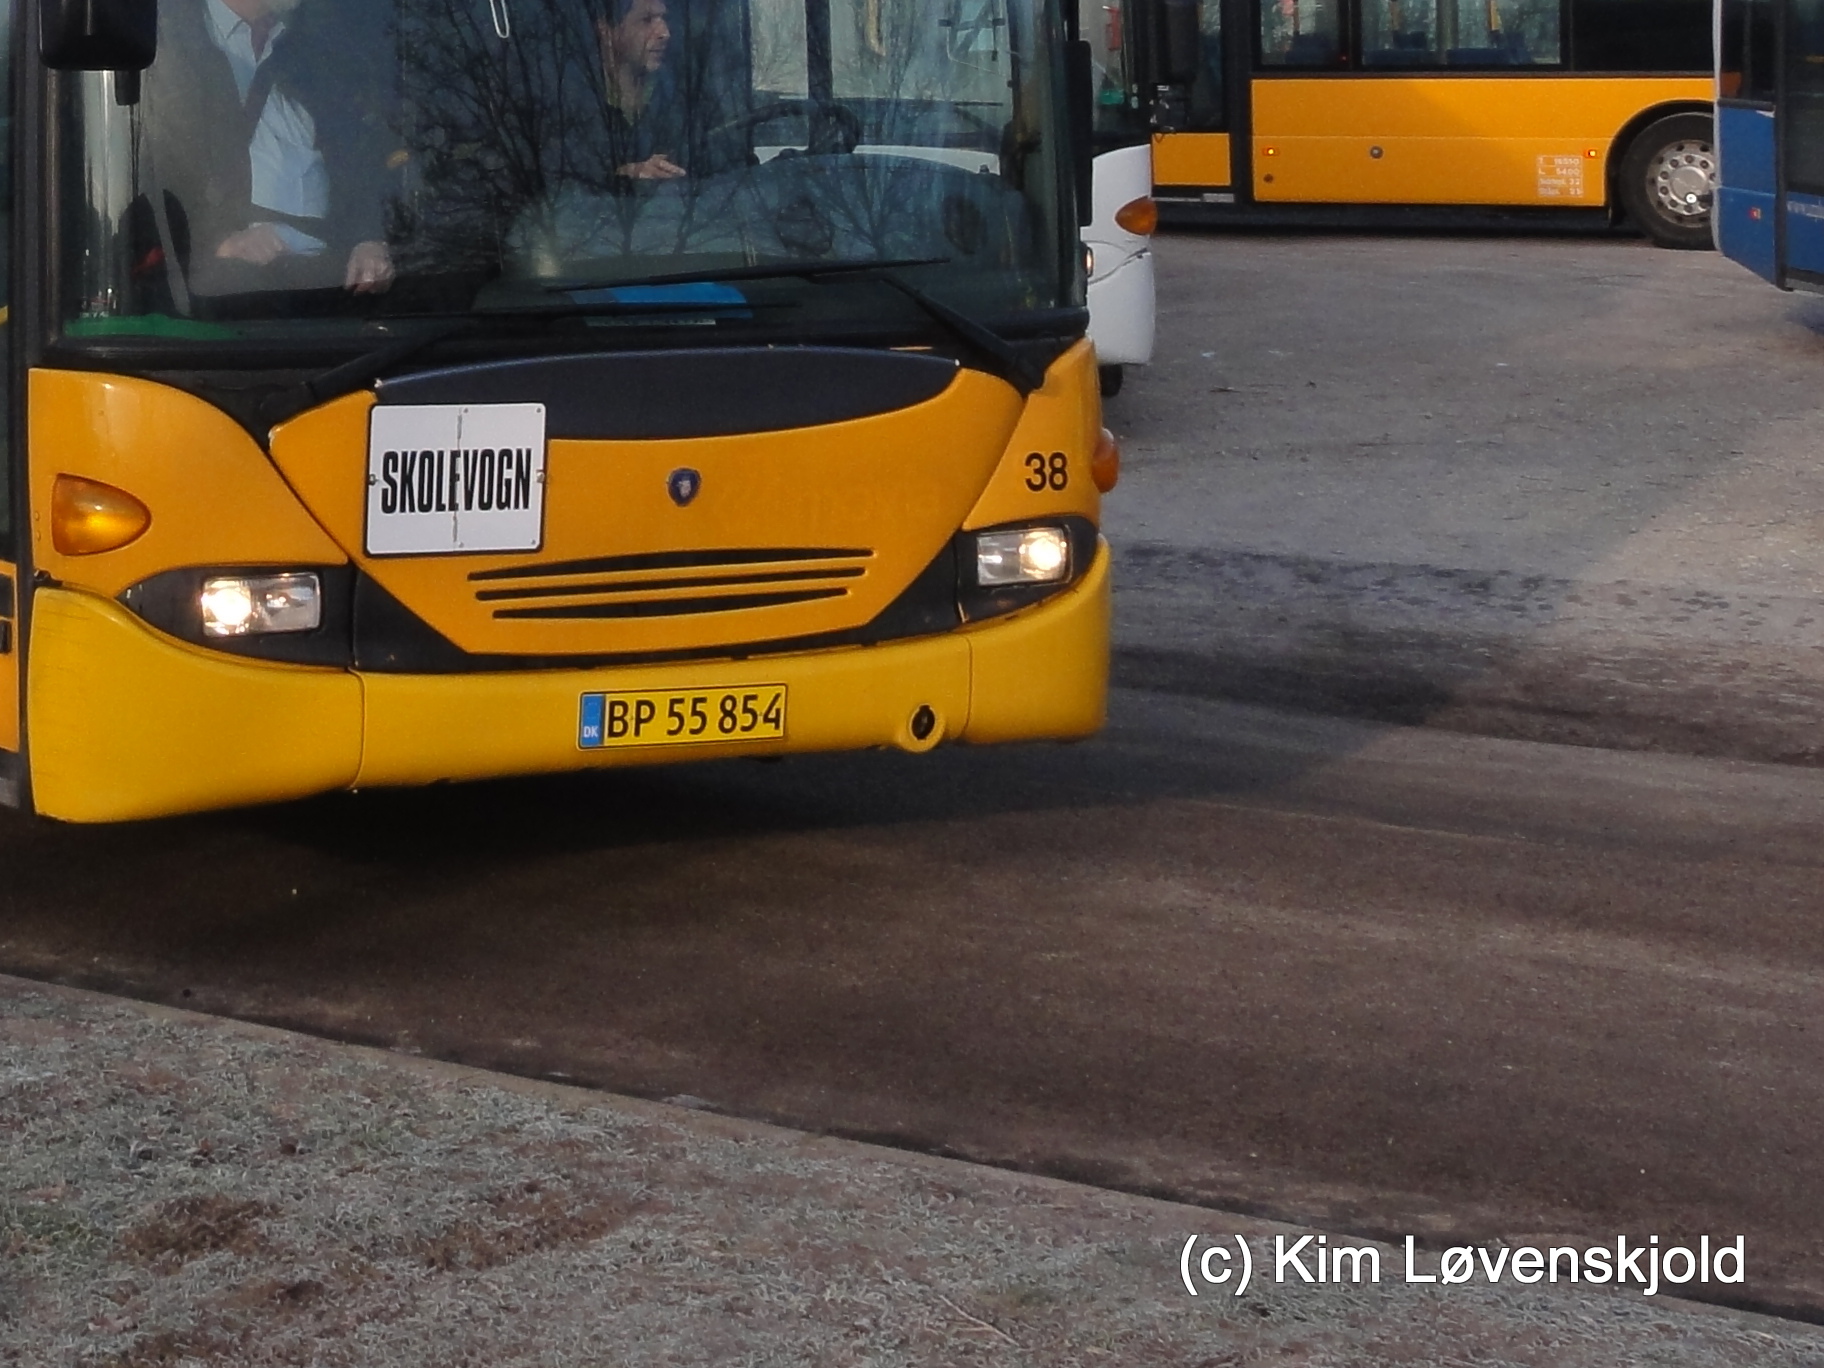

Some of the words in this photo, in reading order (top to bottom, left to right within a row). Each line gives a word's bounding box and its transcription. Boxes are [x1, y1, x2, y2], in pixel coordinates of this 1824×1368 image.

[381, 448, 532, 514] SKOLEVOGN
[1024, 452, 1068, 492] 38
[583, 725, 599, 738] DK
[607, 699, 655, 738] BP
[666, 696, 708, 736] 55
[717, 692, 782, 734] 854
